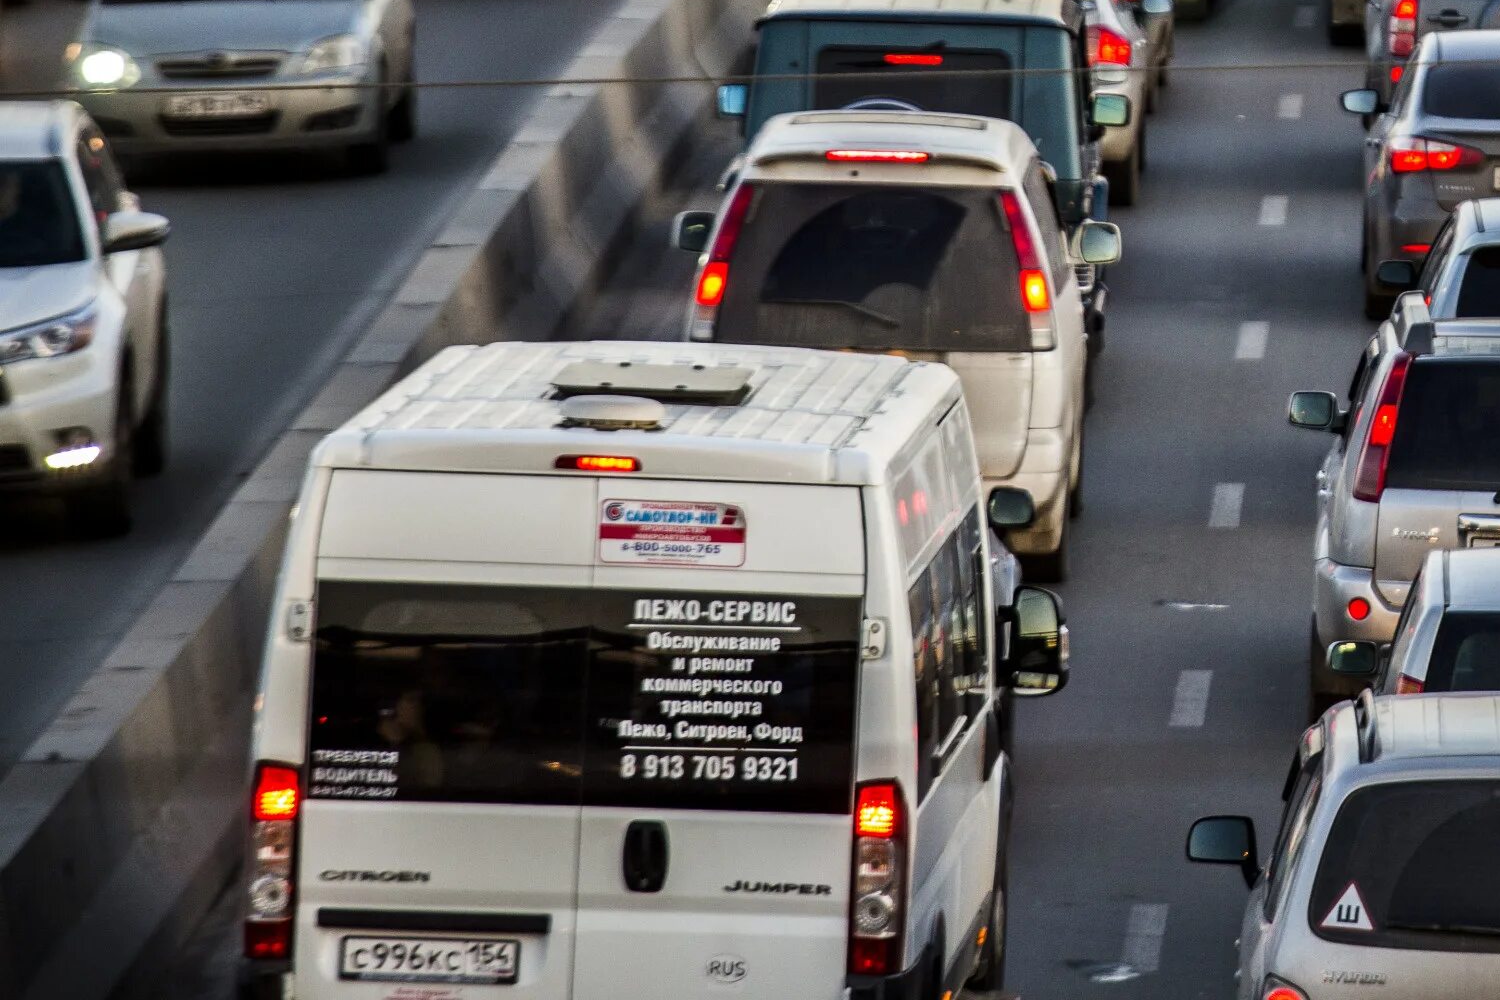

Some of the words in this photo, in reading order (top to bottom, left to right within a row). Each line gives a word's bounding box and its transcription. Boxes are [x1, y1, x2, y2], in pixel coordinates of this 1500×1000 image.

[634, 599, 796, 623] ПЕЖО-СЕРВИС
[648, 631, 781, 652] Обслуживание
[671, 657, 686, 670] и
[689, 657, 754, 674] ремонт
[642, 677, 782, 696] коммерческого
[661, 700, 762, 717] транспорта
[618, 720, 672, 739] Пежо,
[675, 720, 752, 742] Ситроен,
[753, 722, 803, 743] Форд
[312, 767, 398, 783] ВОДИТЕЛЬ
[620, 754, 637, 778] 8
[643, 754, 685, 778] 913
[692, 755, 735, 779] 705
[742, 756, 799, 780] 9321
[320, 870, 430, 882] CITROEN
[724, 880, 832, 895] JUMPER
[1337, 904, 1360, 923] Ш
[353, 943, 460, 971] С996КС
[466, 943, 508, 965] 154
[709, 960, 746, 977] RUS
